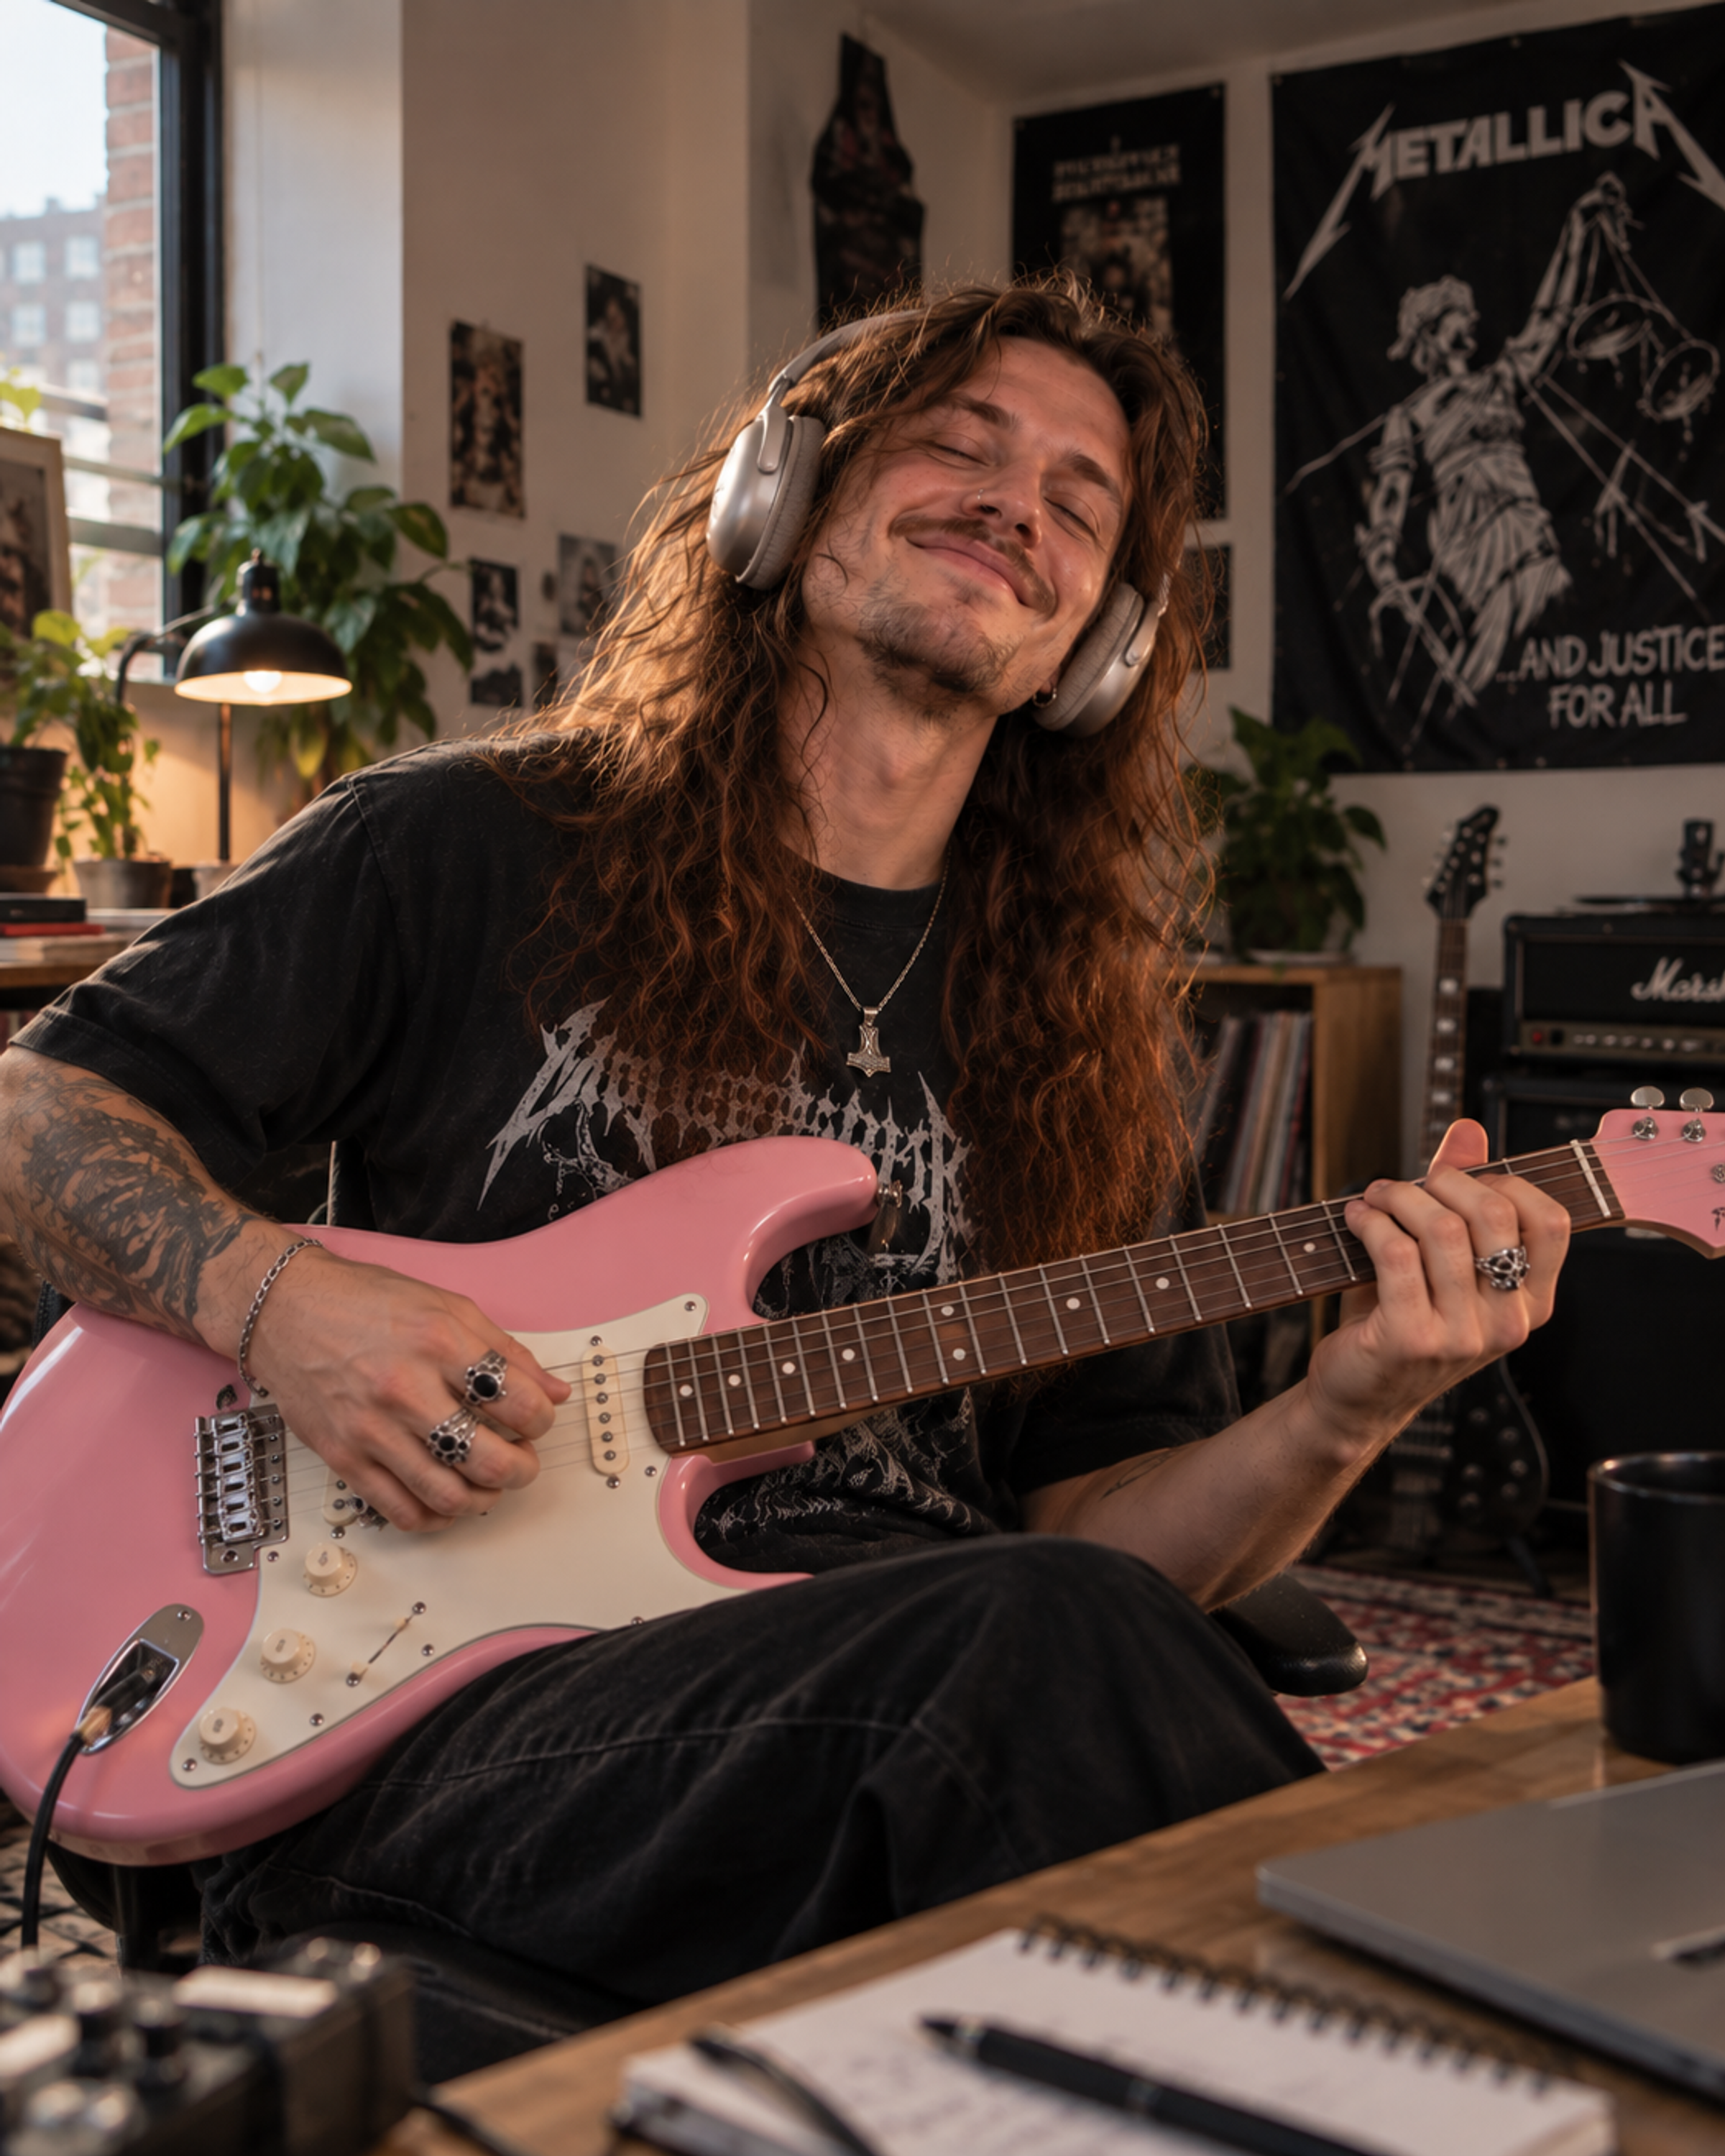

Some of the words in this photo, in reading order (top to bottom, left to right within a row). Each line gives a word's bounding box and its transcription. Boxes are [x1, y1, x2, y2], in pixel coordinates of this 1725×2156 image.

[1284, 58, 1725, 302] METALLICA
[1587, 625, 1725, 678] JUSTICE
[1547, 683, 1616, 729] FOR
[1619, 679, 1688, 728] ALL
[1630, 956, 1725, 1003] Mars
